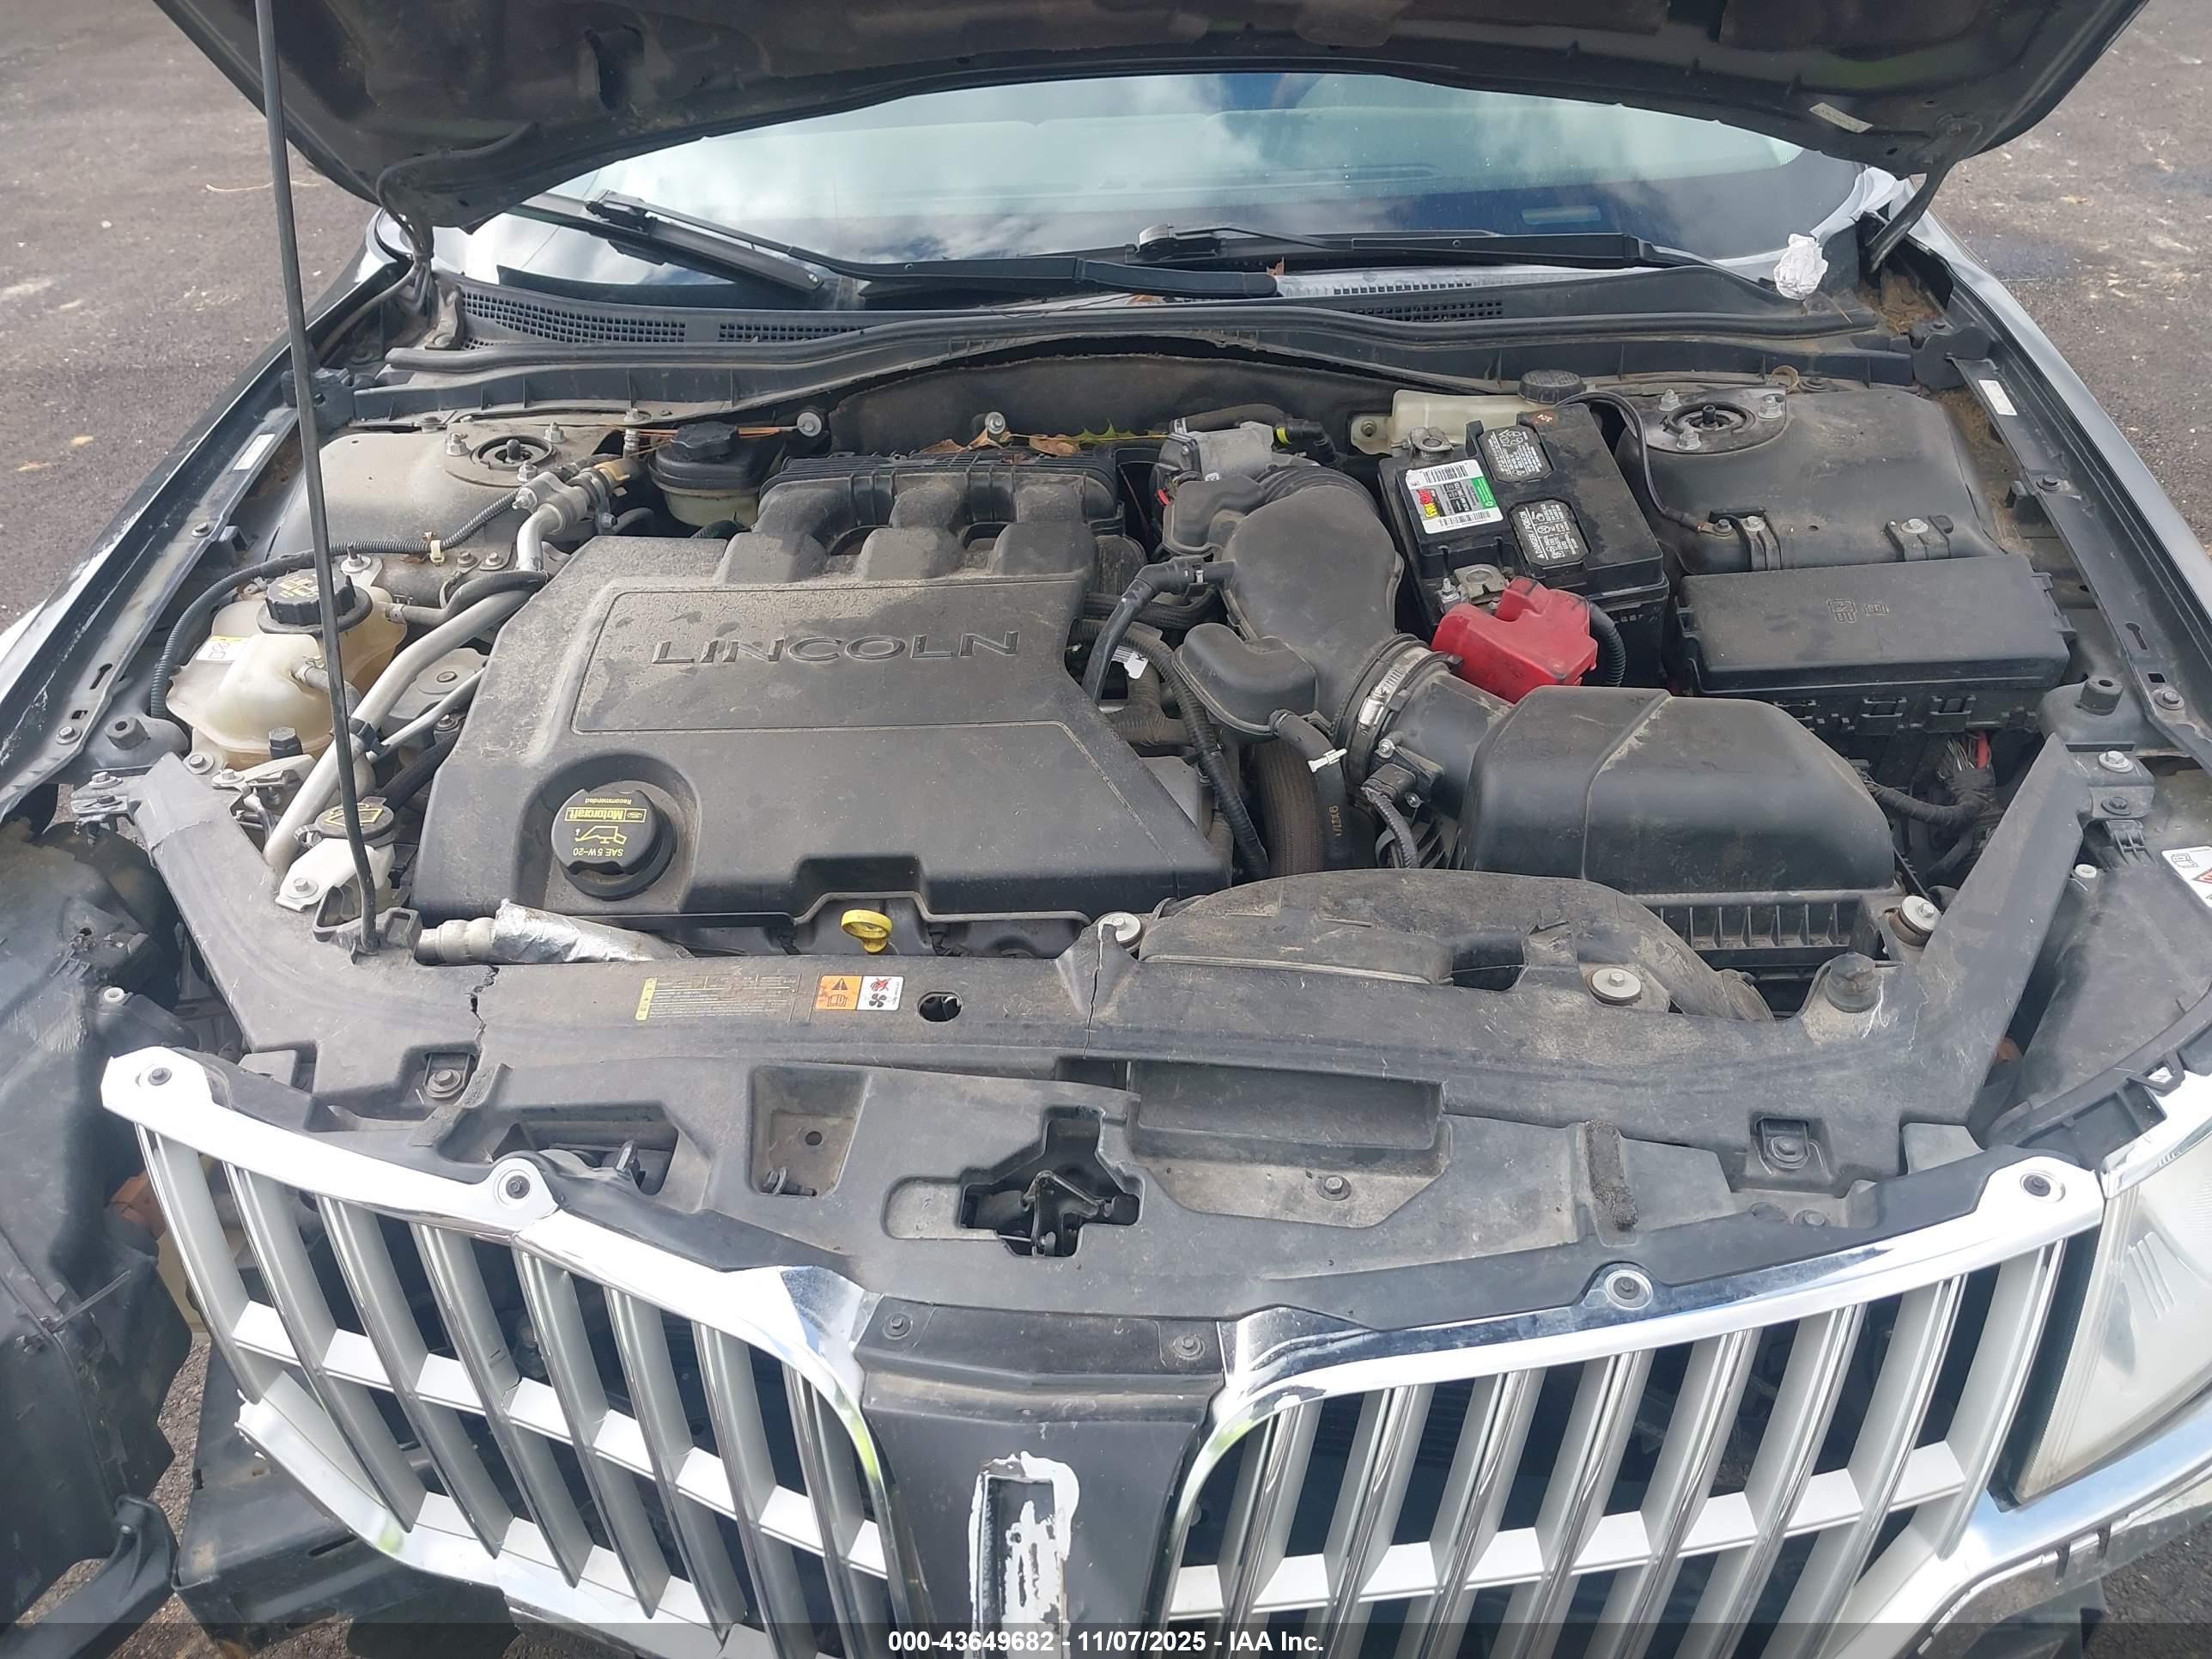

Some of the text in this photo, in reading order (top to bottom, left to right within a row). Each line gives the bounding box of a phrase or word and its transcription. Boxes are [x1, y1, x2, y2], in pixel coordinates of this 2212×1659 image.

[651, 630, 1020, 665] LINCOLN
[585, 797, 633, 805] Recommended
[568, 809, 624, 820] Motorcraft
[573, 847, 624, 857] SAE 5W-20
